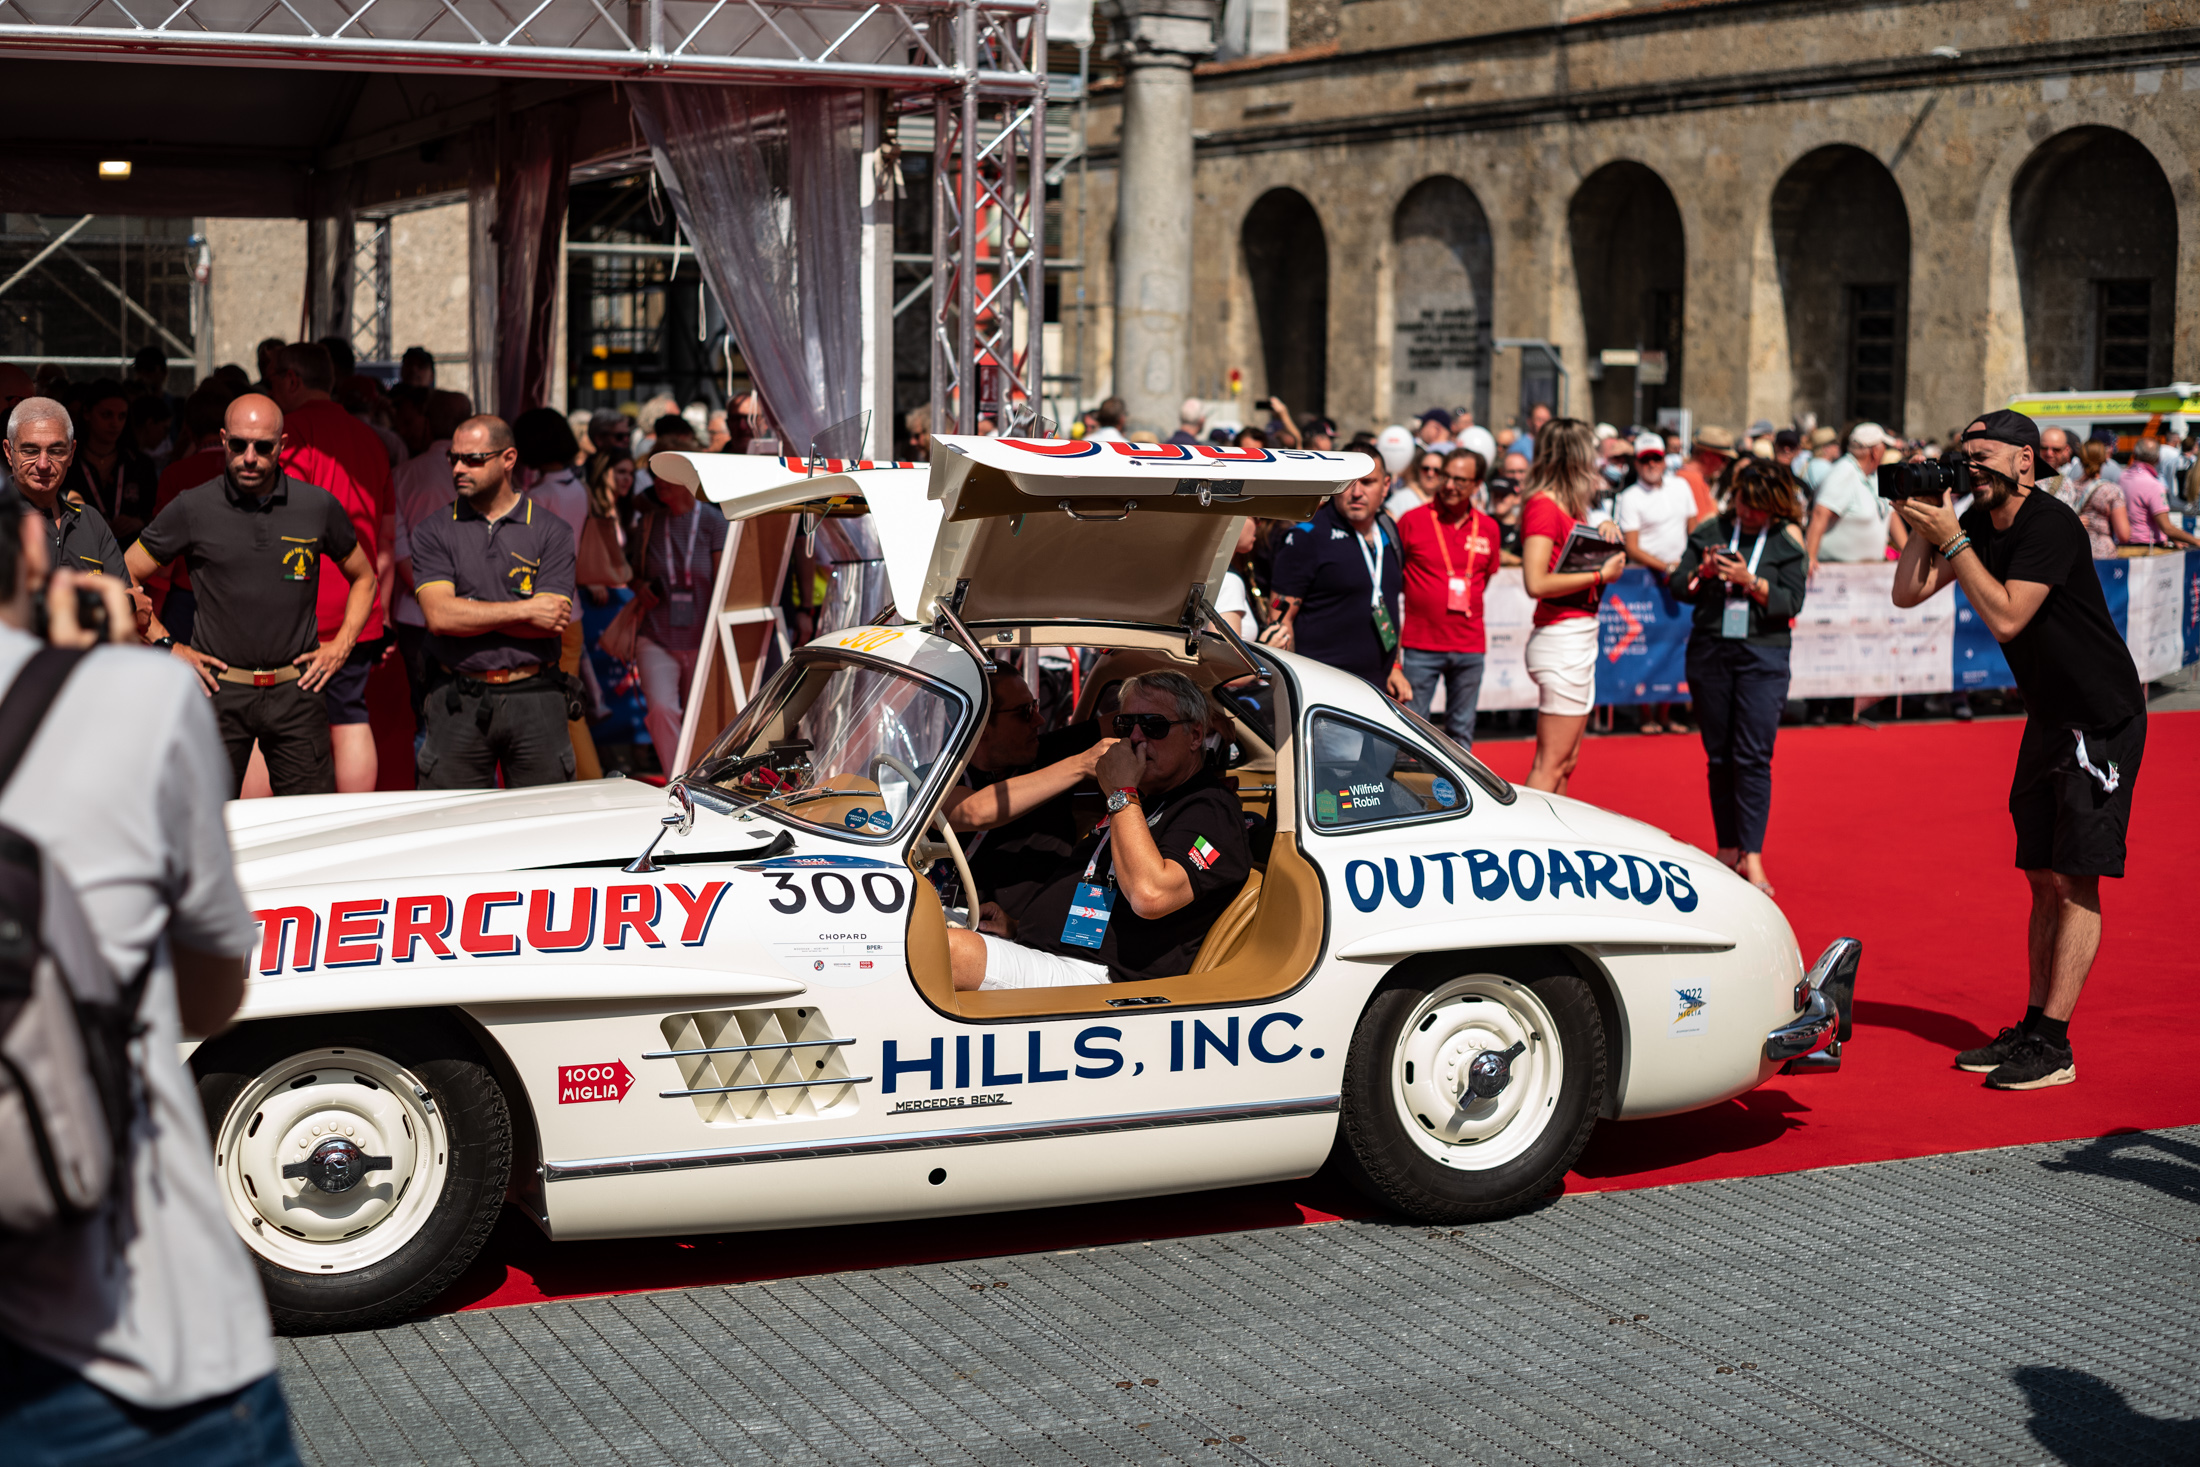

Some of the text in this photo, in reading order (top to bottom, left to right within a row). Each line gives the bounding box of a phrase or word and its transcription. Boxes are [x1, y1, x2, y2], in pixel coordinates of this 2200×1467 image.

[1350, 782, 1384, 796] Wilfried
[1353, 796, 1381, 808] Robin
[1345, 848, 1699, 913] OUTBOARDS
[762, 872, 905, 914] 300
[1679, 987, 1702, 1001] 2022
[881, 1012, 1326, 1094] HILLS, INC.
[565, 1066, 615, 1082] 1000
[562, 1084, 618, 1102] MIGLIA
[895, 1093, 1004, 1111] MERCEDES BENZ
